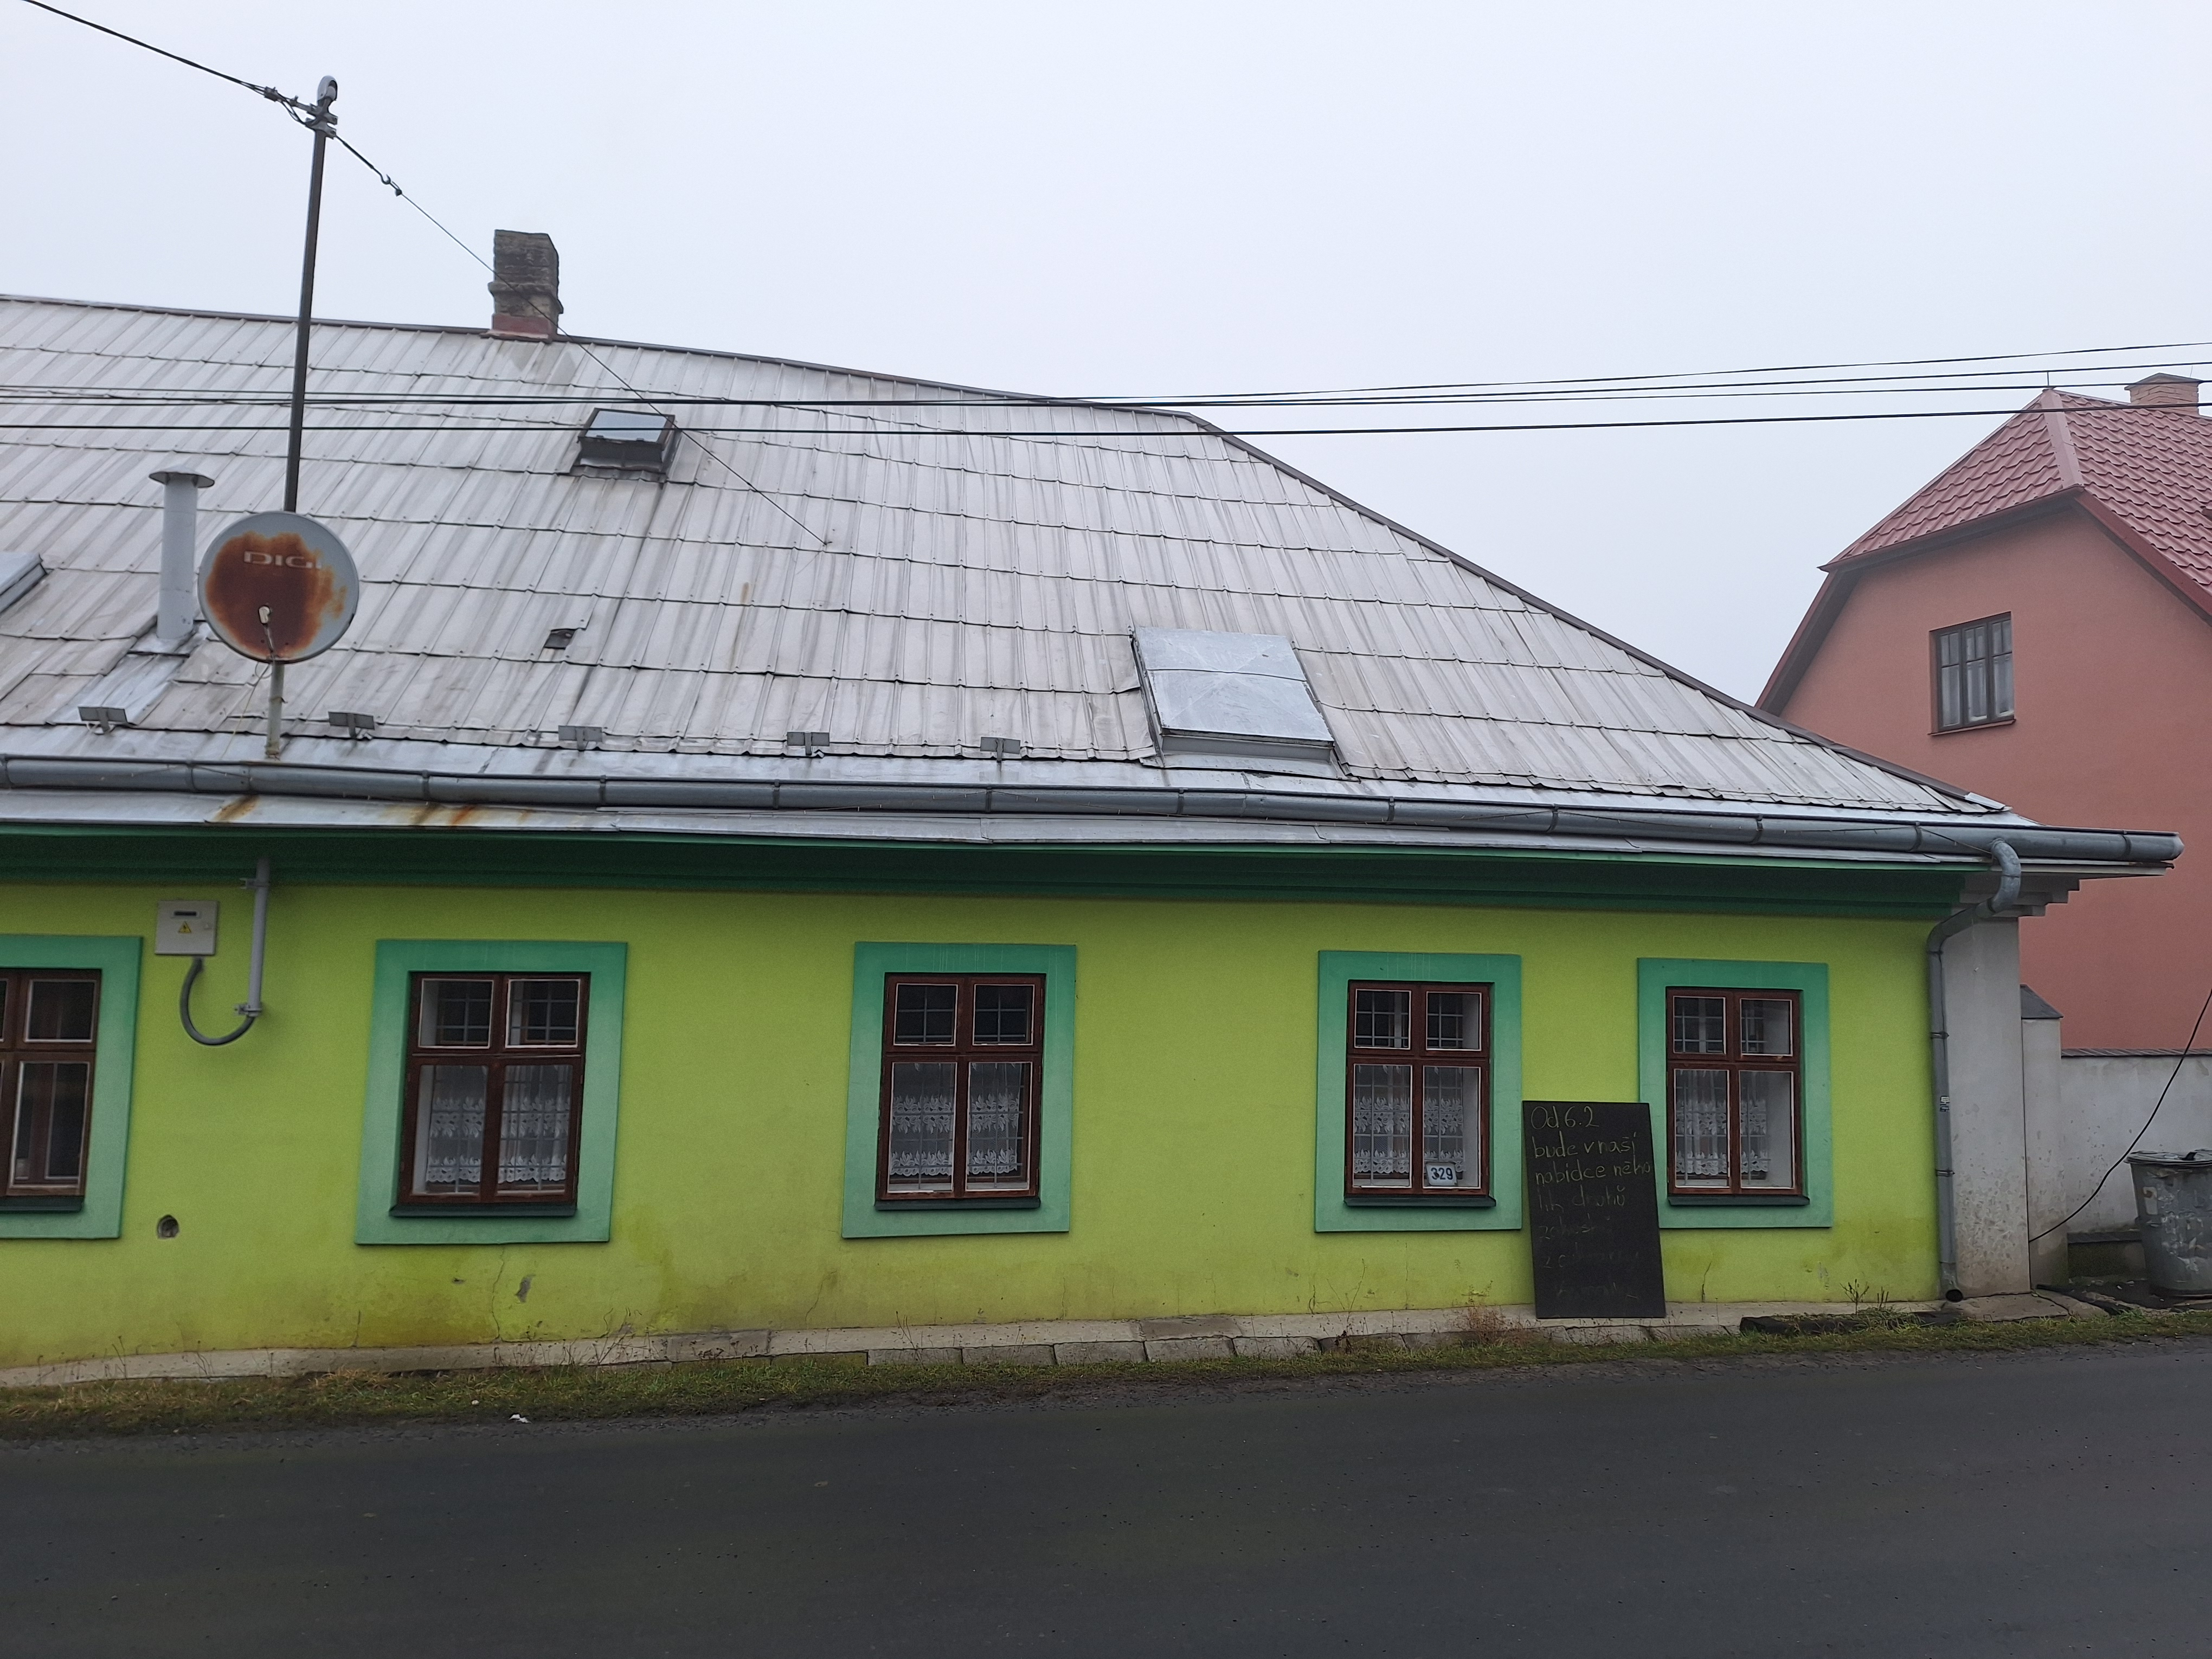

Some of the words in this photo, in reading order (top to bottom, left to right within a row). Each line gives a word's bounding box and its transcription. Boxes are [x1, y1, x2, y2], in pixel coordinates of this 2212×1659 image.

[1531, 1105, 1559, 1130] Od
[1564, 1105, 1599, 1128] 6.2
[1532, 1130, 1578, 1159] bude
[1584, 1141, 1595, 1153] v
[1431, 1167, 1453, 1180] 329
